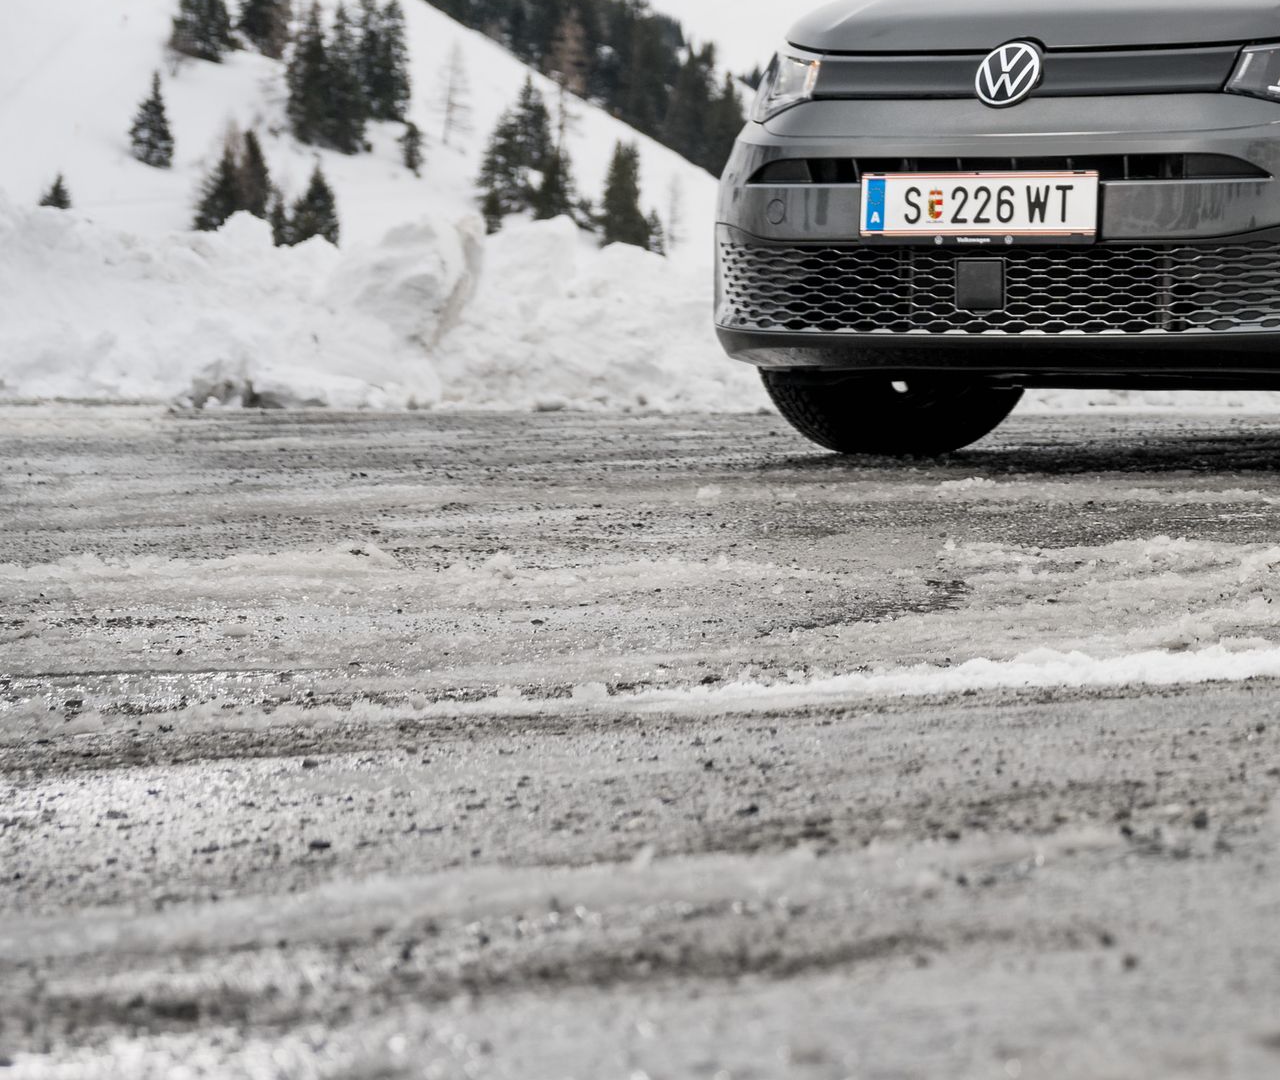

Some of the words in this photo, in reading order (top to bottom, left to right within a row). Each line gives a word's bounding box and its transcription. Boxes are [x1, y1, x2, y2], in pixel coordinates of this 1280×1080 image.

[870, 211, 881, 223] A
[904, 186, 922, 224] S
[951, 185, 1015, 224] 226
[1026, 185, 1074, 224] WT
